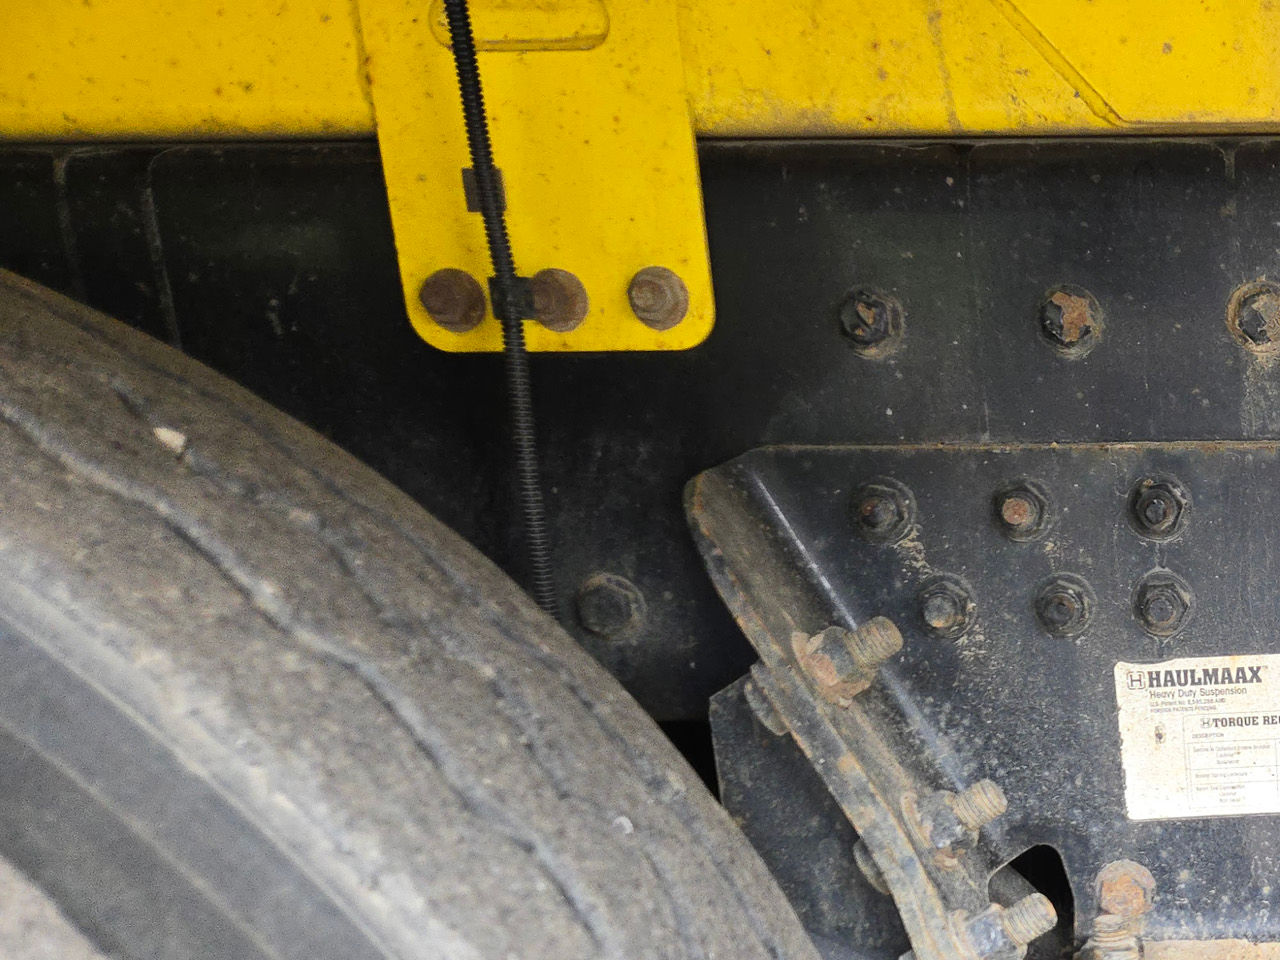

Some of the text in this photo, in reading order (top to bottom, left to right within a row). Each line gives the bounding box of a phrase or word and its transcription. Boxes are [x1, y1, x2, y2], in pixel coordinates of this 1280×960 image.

[1148, 666, 1262, 688] HAULMAAX
[1149, 686, 1248, 699] Heavy Duty Suspension
[1212, 716, 1259, 728] TORQUE
